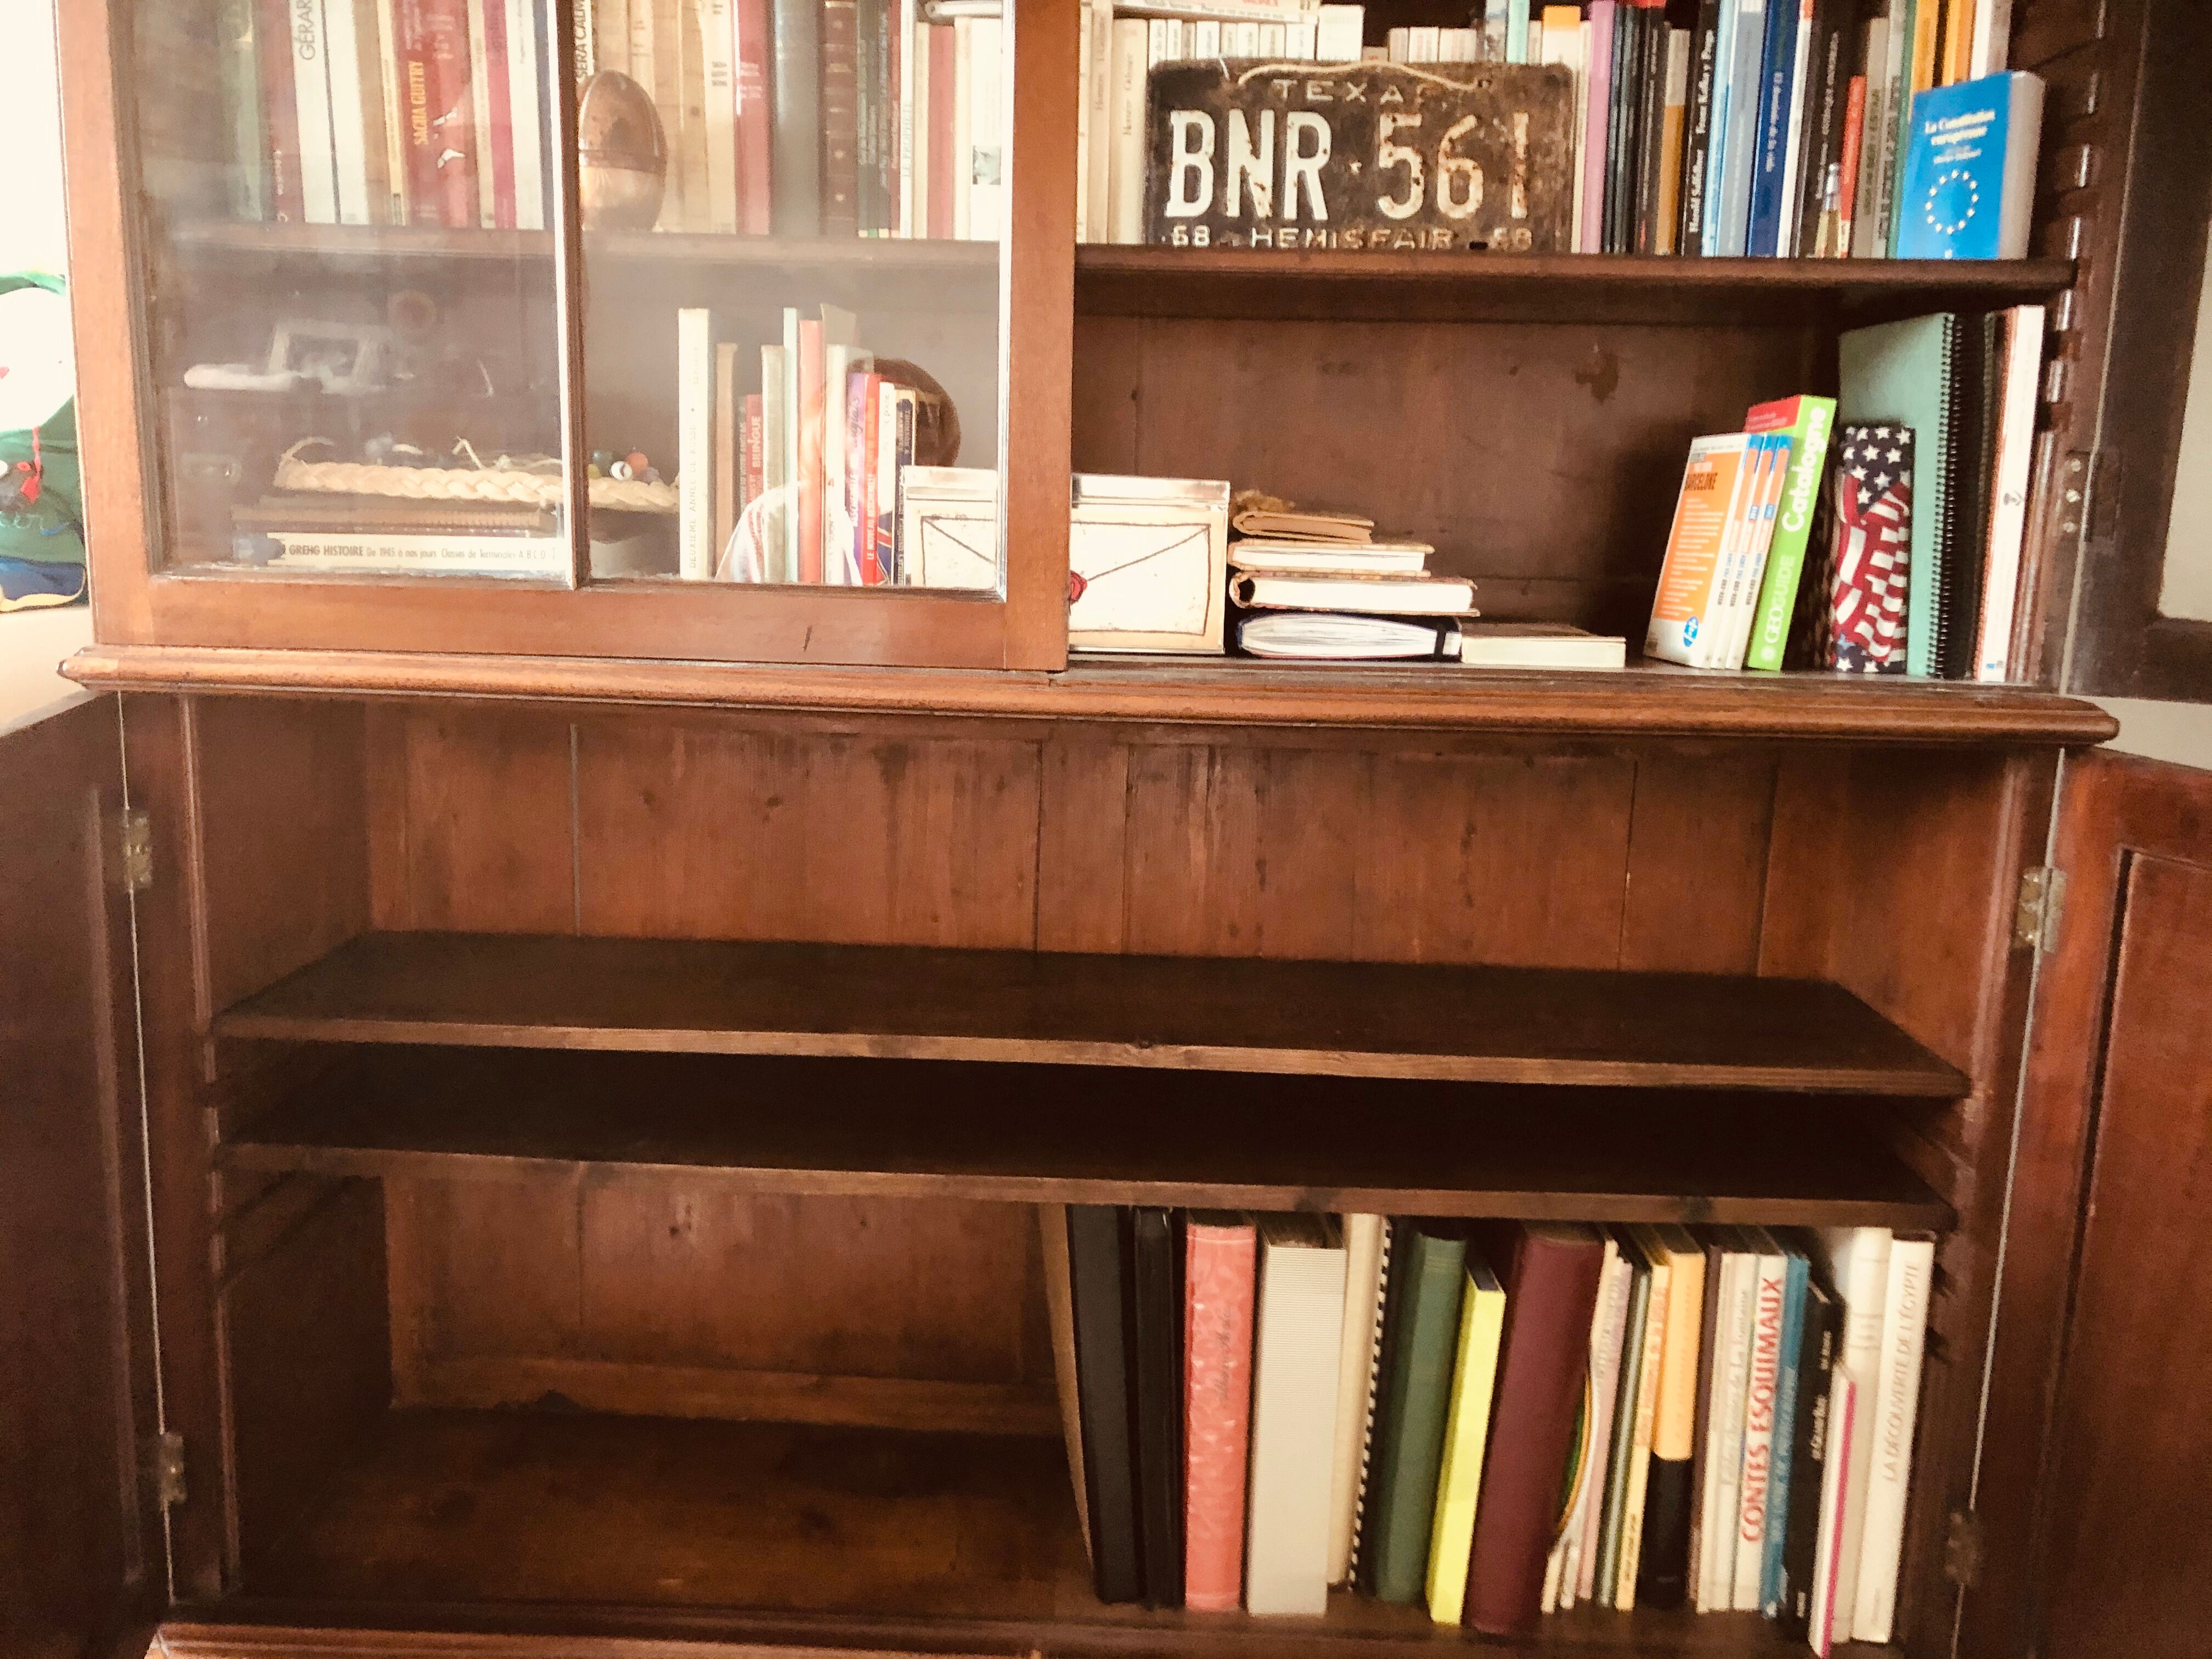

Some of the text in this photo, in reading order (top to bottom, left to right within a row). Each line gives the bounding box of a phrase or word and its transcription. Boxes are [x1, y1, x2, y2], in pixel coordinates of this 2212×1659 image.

[408, 60, 426, 105] GUITRY
[411, 107, 428, 145] SACHA
[1165, 109, 1331, 221] BNR
[1378, 111, 1530, 219] 561
[1171, 225, 1210, 248] 68
[1250, 227, 1454, 250] HEMISFAIR
[747, 415, 761, 468] BILINGUE
[850, 396, 863, 448] anglais
[1782, 406, 1827, 532] Catalogne
[289, 545, 320, 556] GREHG
[324, 545, 364, 557] HISTOIRE
[380, 547, 396, 557] 1945
[419, 549, 437, 560] jours
[467, 548, 477, 558] de
[1764, 554, 1796, 644] GEOGUIDE
[1751, 1277, 1784, 1433] ESQUIMAUX
[1894, 1334, 1914, 1356] DE
[1741, 1442, 1768, 1543] CONTES
